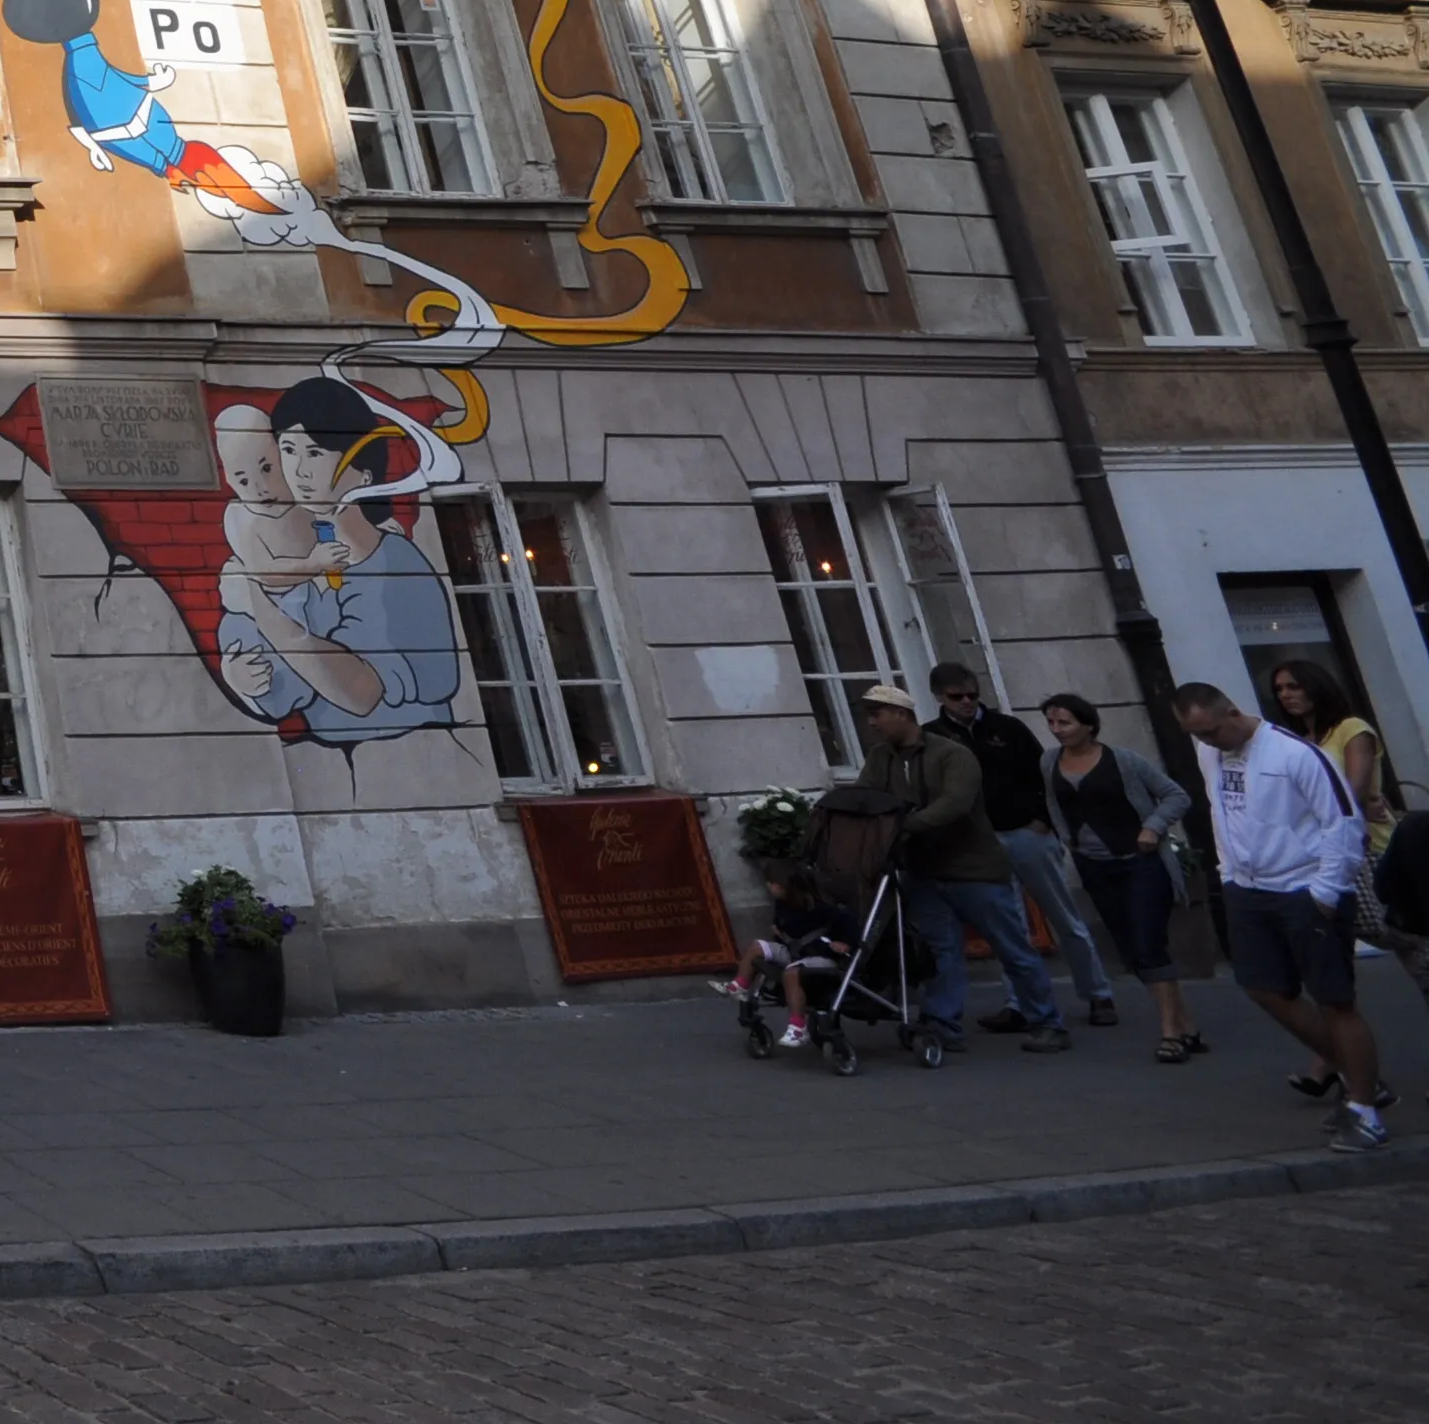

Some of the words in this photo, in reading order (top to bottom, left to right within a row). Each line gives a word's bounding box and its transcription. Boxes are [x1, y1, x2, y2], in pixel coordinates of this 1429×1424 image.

[149, 8, 221, 54] Po
[86, 461, 141, 475] POLON
[150, 461, 179, 476] RAD
